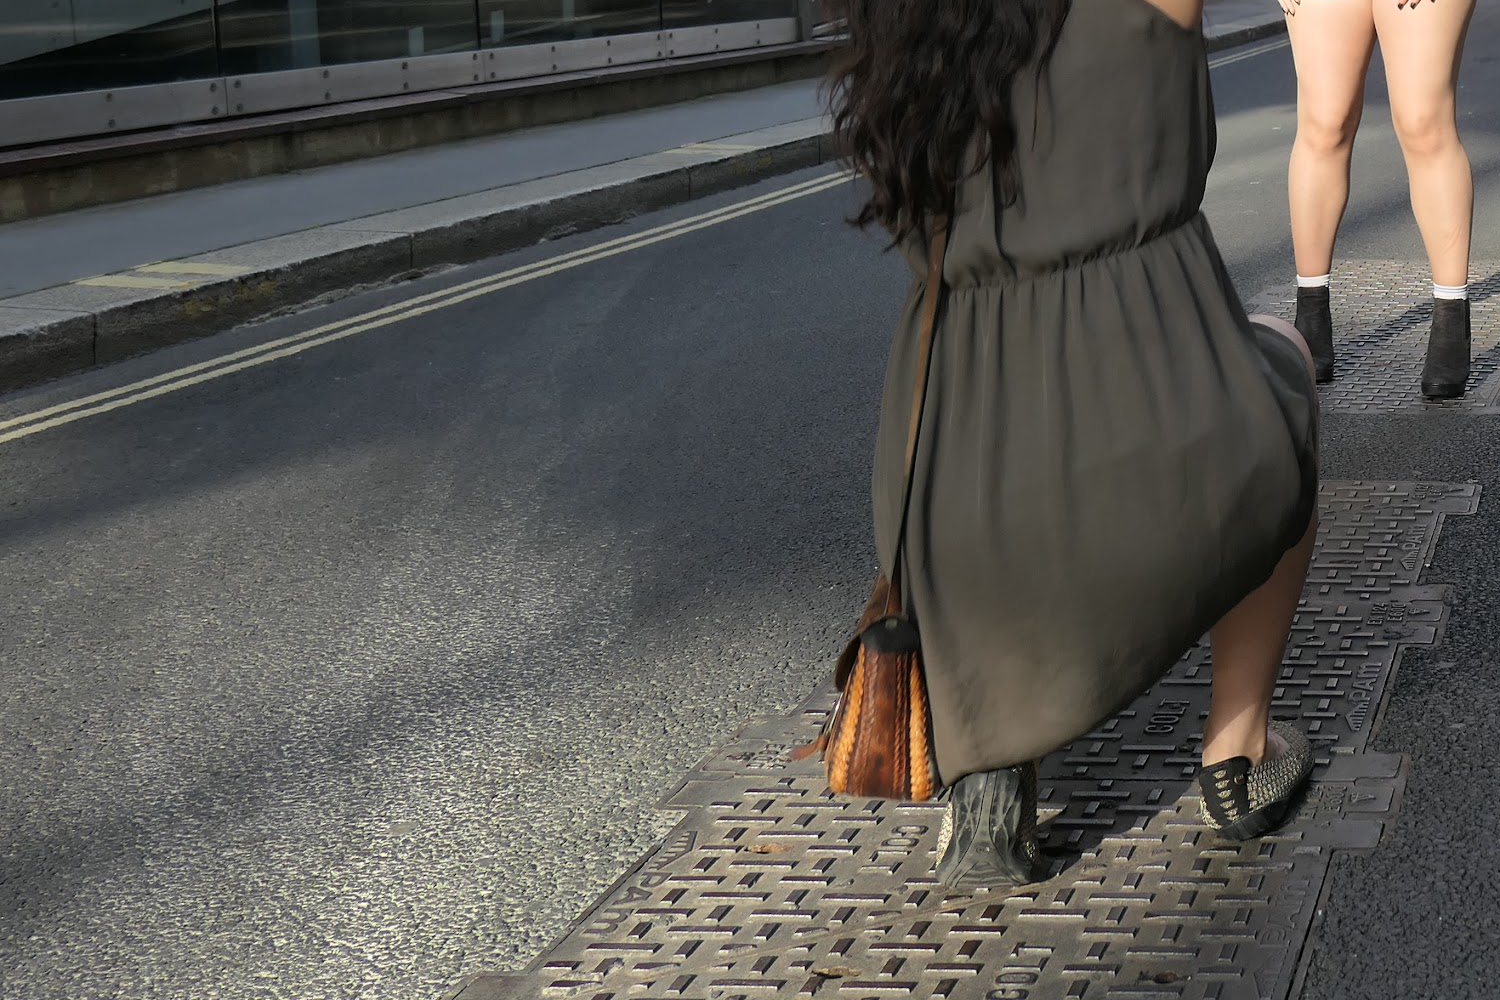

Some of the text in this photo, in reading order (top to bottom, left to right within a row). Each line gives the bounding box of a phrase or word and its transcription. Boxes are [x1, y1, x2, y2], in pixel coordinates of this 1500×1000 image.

[1144, 698, 1190, 733] COLT
[860, 825, 929, 875] COLT
[985, 941, 1056, 1000] COLT
